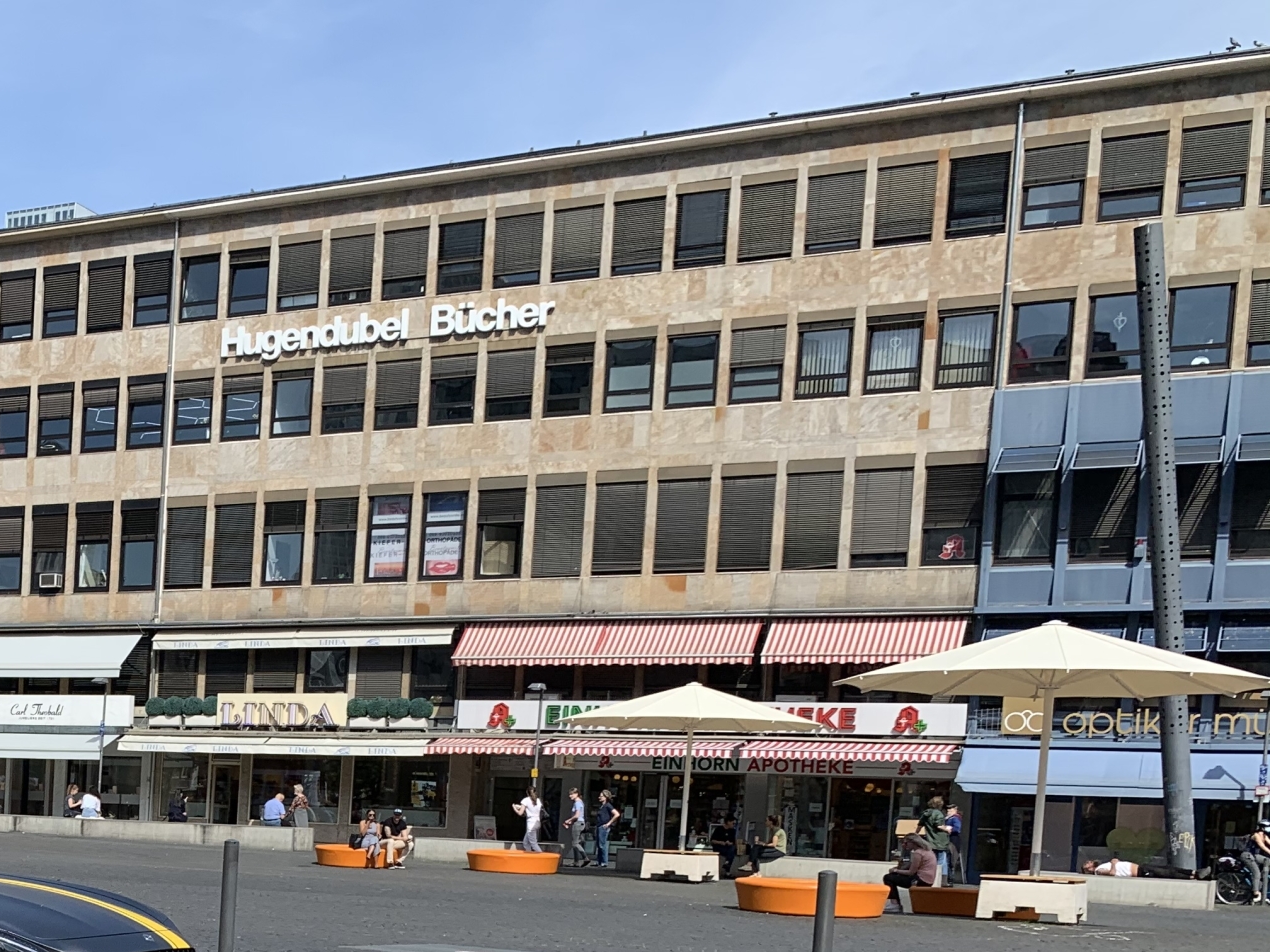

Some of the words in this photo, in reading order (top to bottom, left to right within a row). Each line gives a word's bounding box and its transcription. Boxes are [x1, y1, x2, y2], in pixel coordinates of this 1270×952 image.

[221, 308, 409, 360] Hugendubel
[430, 298, 556, 336] Bücher
[10, 703, 28, 716] Carl
[220, 702, 338, 728] LINDA
[1062, 708, 1201, 738] optikr
[747, 758, 854, 774] APOTHEKE
